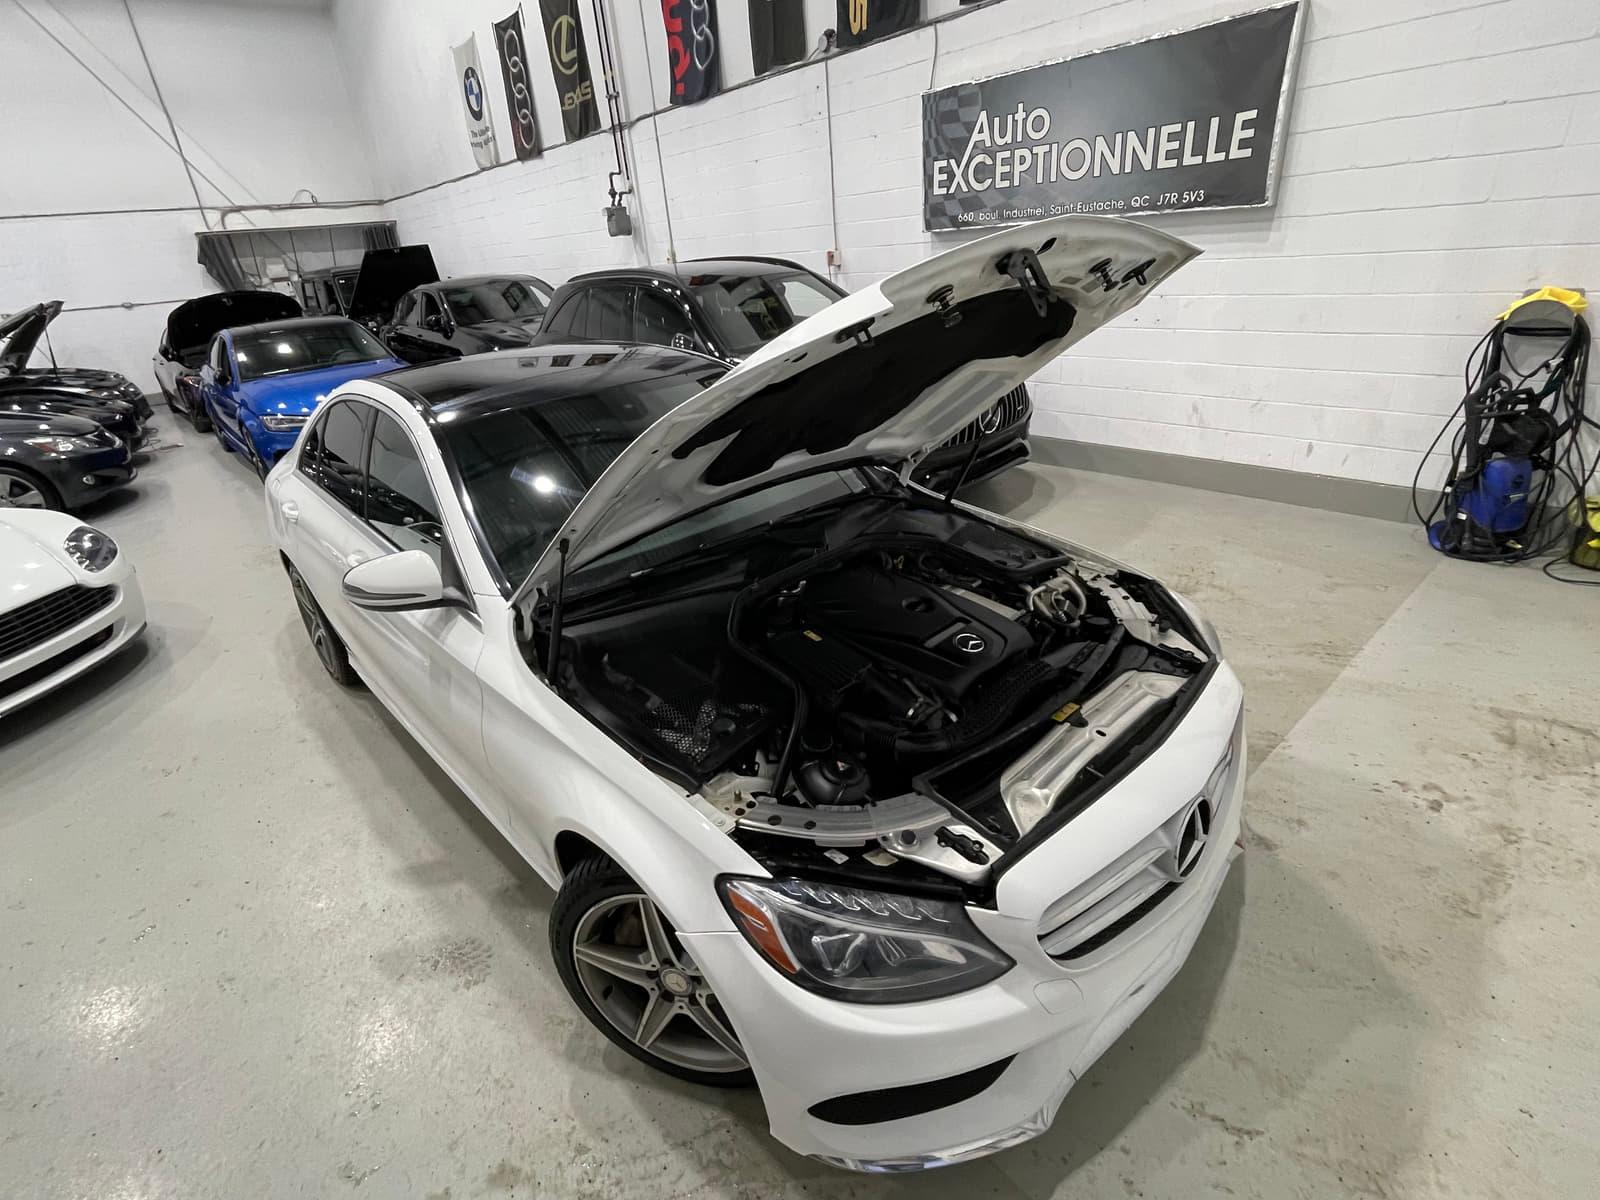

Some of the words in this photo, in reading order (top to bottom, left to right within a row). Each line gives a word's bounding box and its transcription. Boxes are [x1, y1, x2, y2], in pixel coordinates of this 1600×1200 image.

[968, 102, 1051, 148] Auto
[933, 109, 1258, 195] EXCEPTIONNELLE
[1131, 195, 1151, 208] QC
[1156, 192, 1179, 206] J7R
[1182, 189, 1205, 204] 5V3
